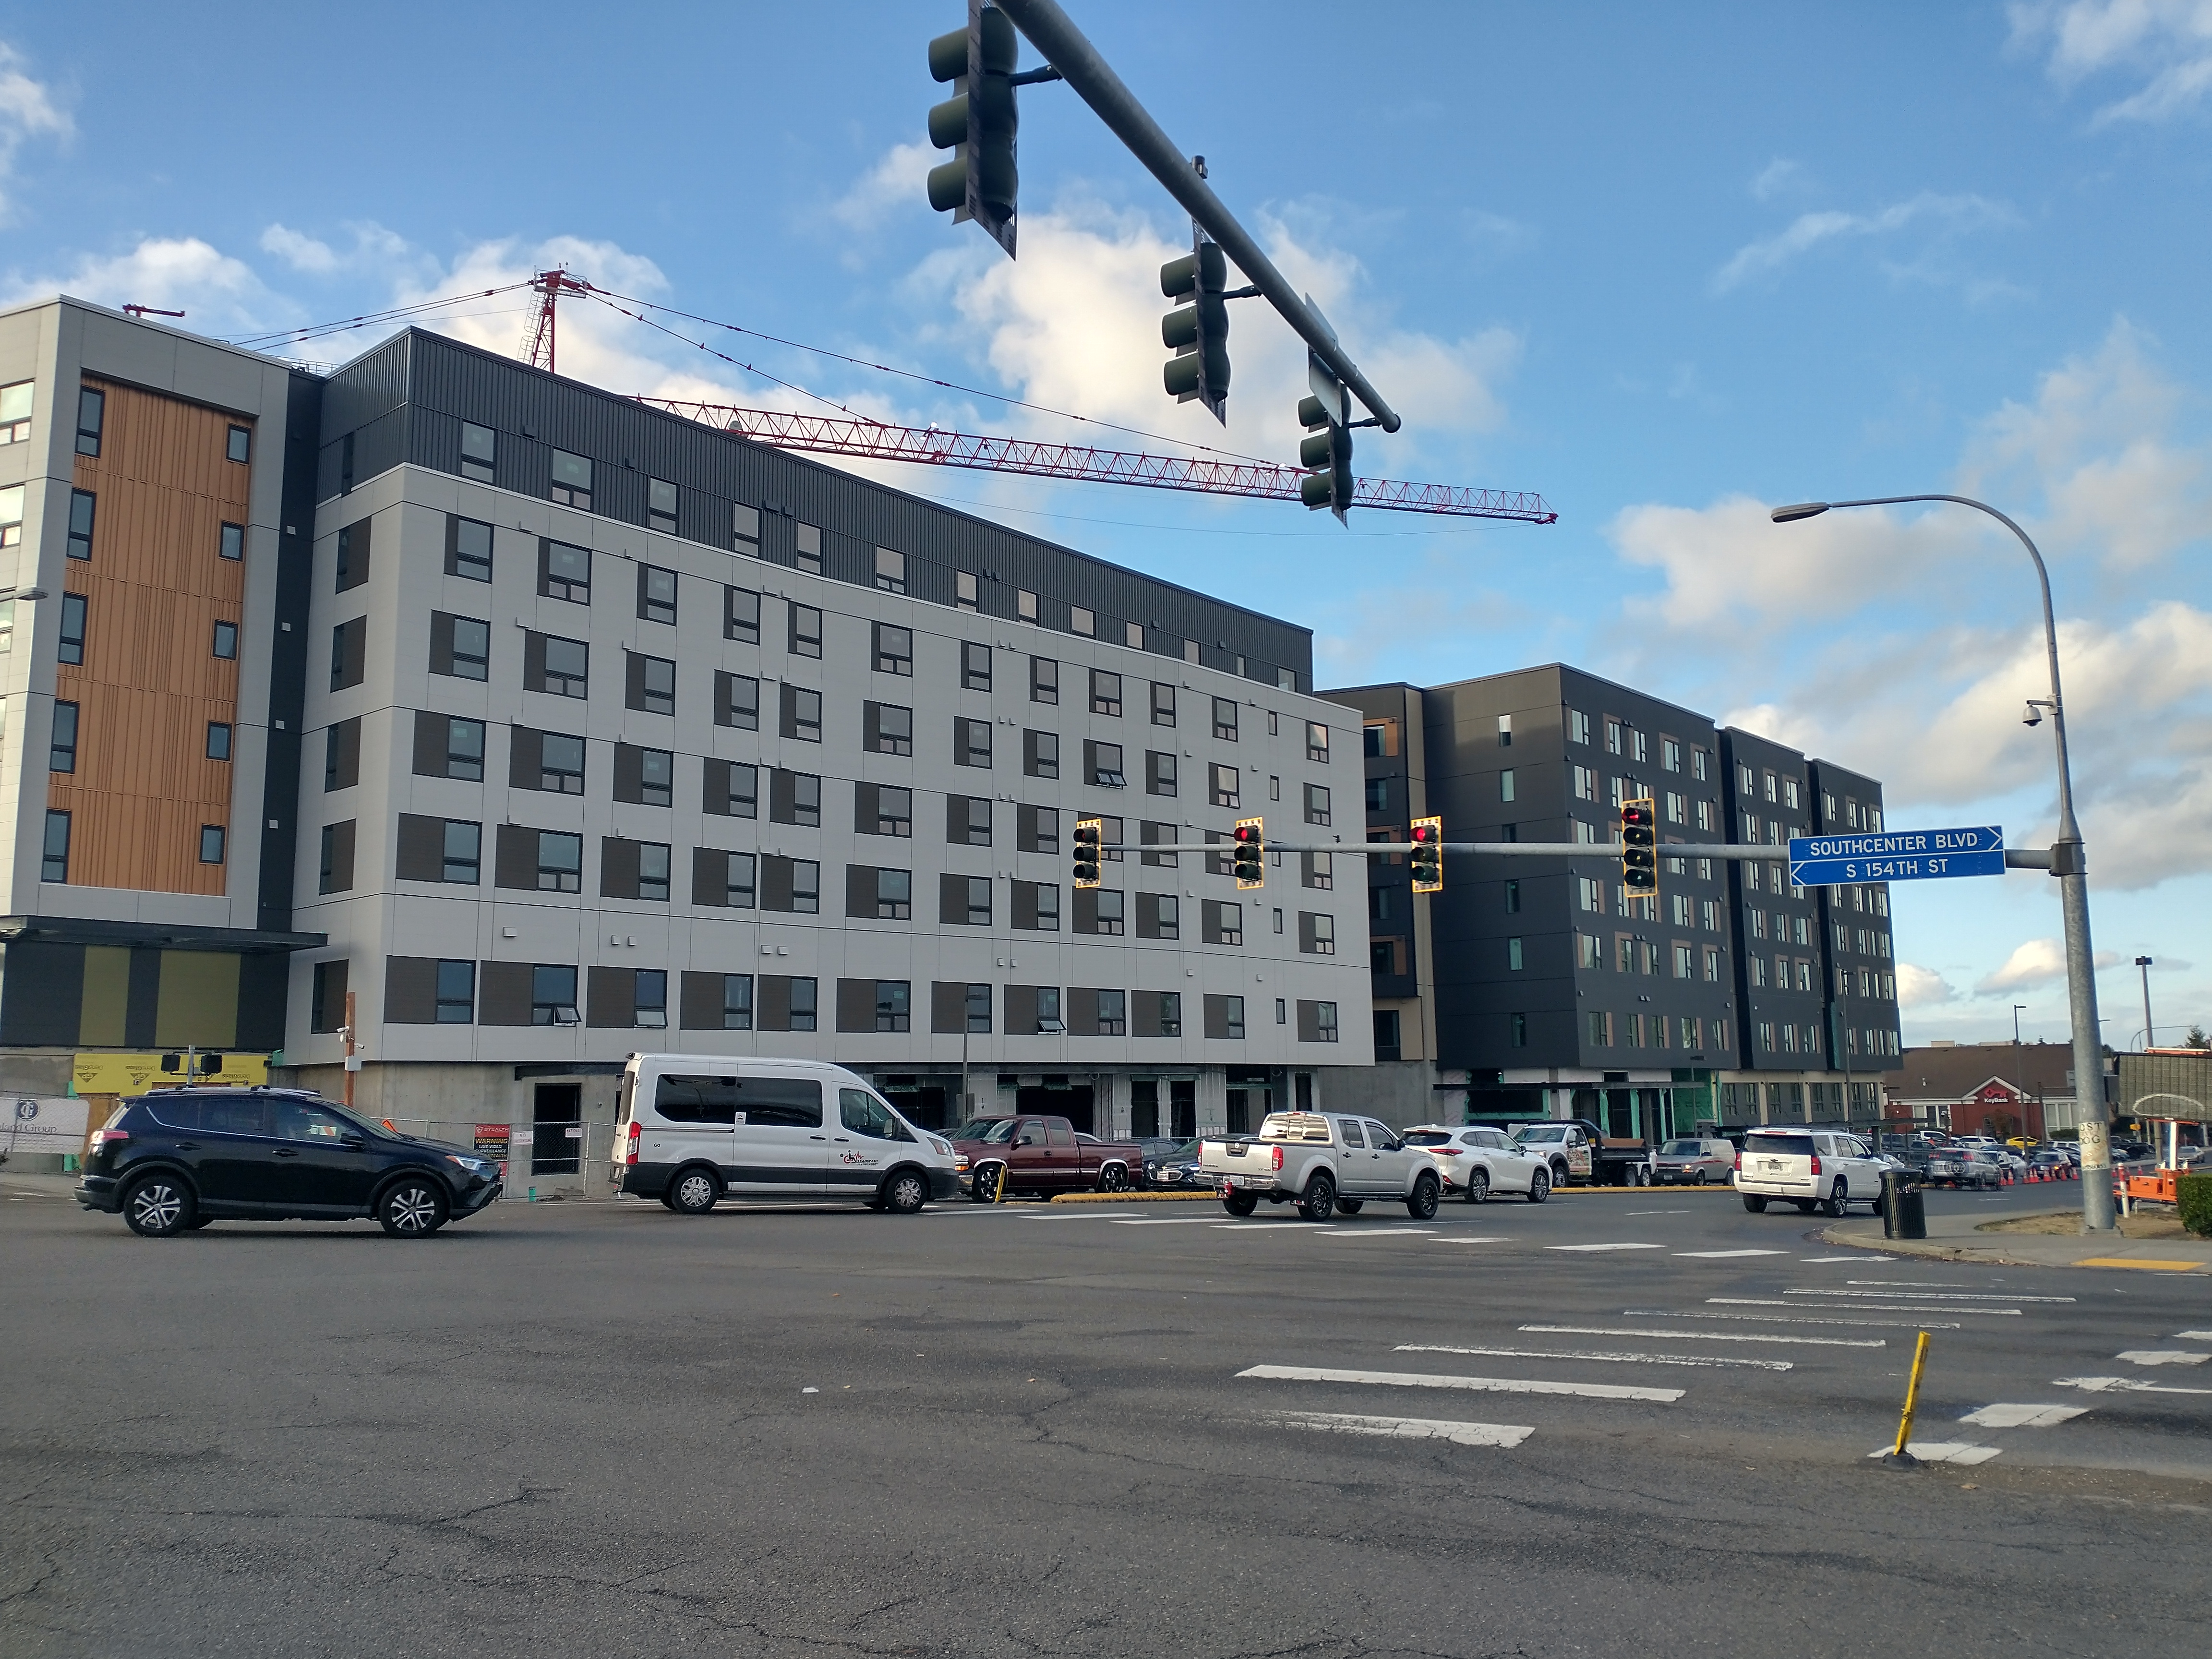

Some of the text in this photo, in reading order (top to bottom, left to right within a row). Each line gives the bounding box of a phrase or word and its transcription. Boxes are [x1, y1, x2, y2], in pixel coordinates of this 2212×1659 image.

[1810, 833, 1978, 856] SOUTHCENTER BLVD
[1846, 859, 1948, 878] S 154TH ST
[25, 1123, 57, 1133] Group
[2080, 1122, 2102, 1131] OST
